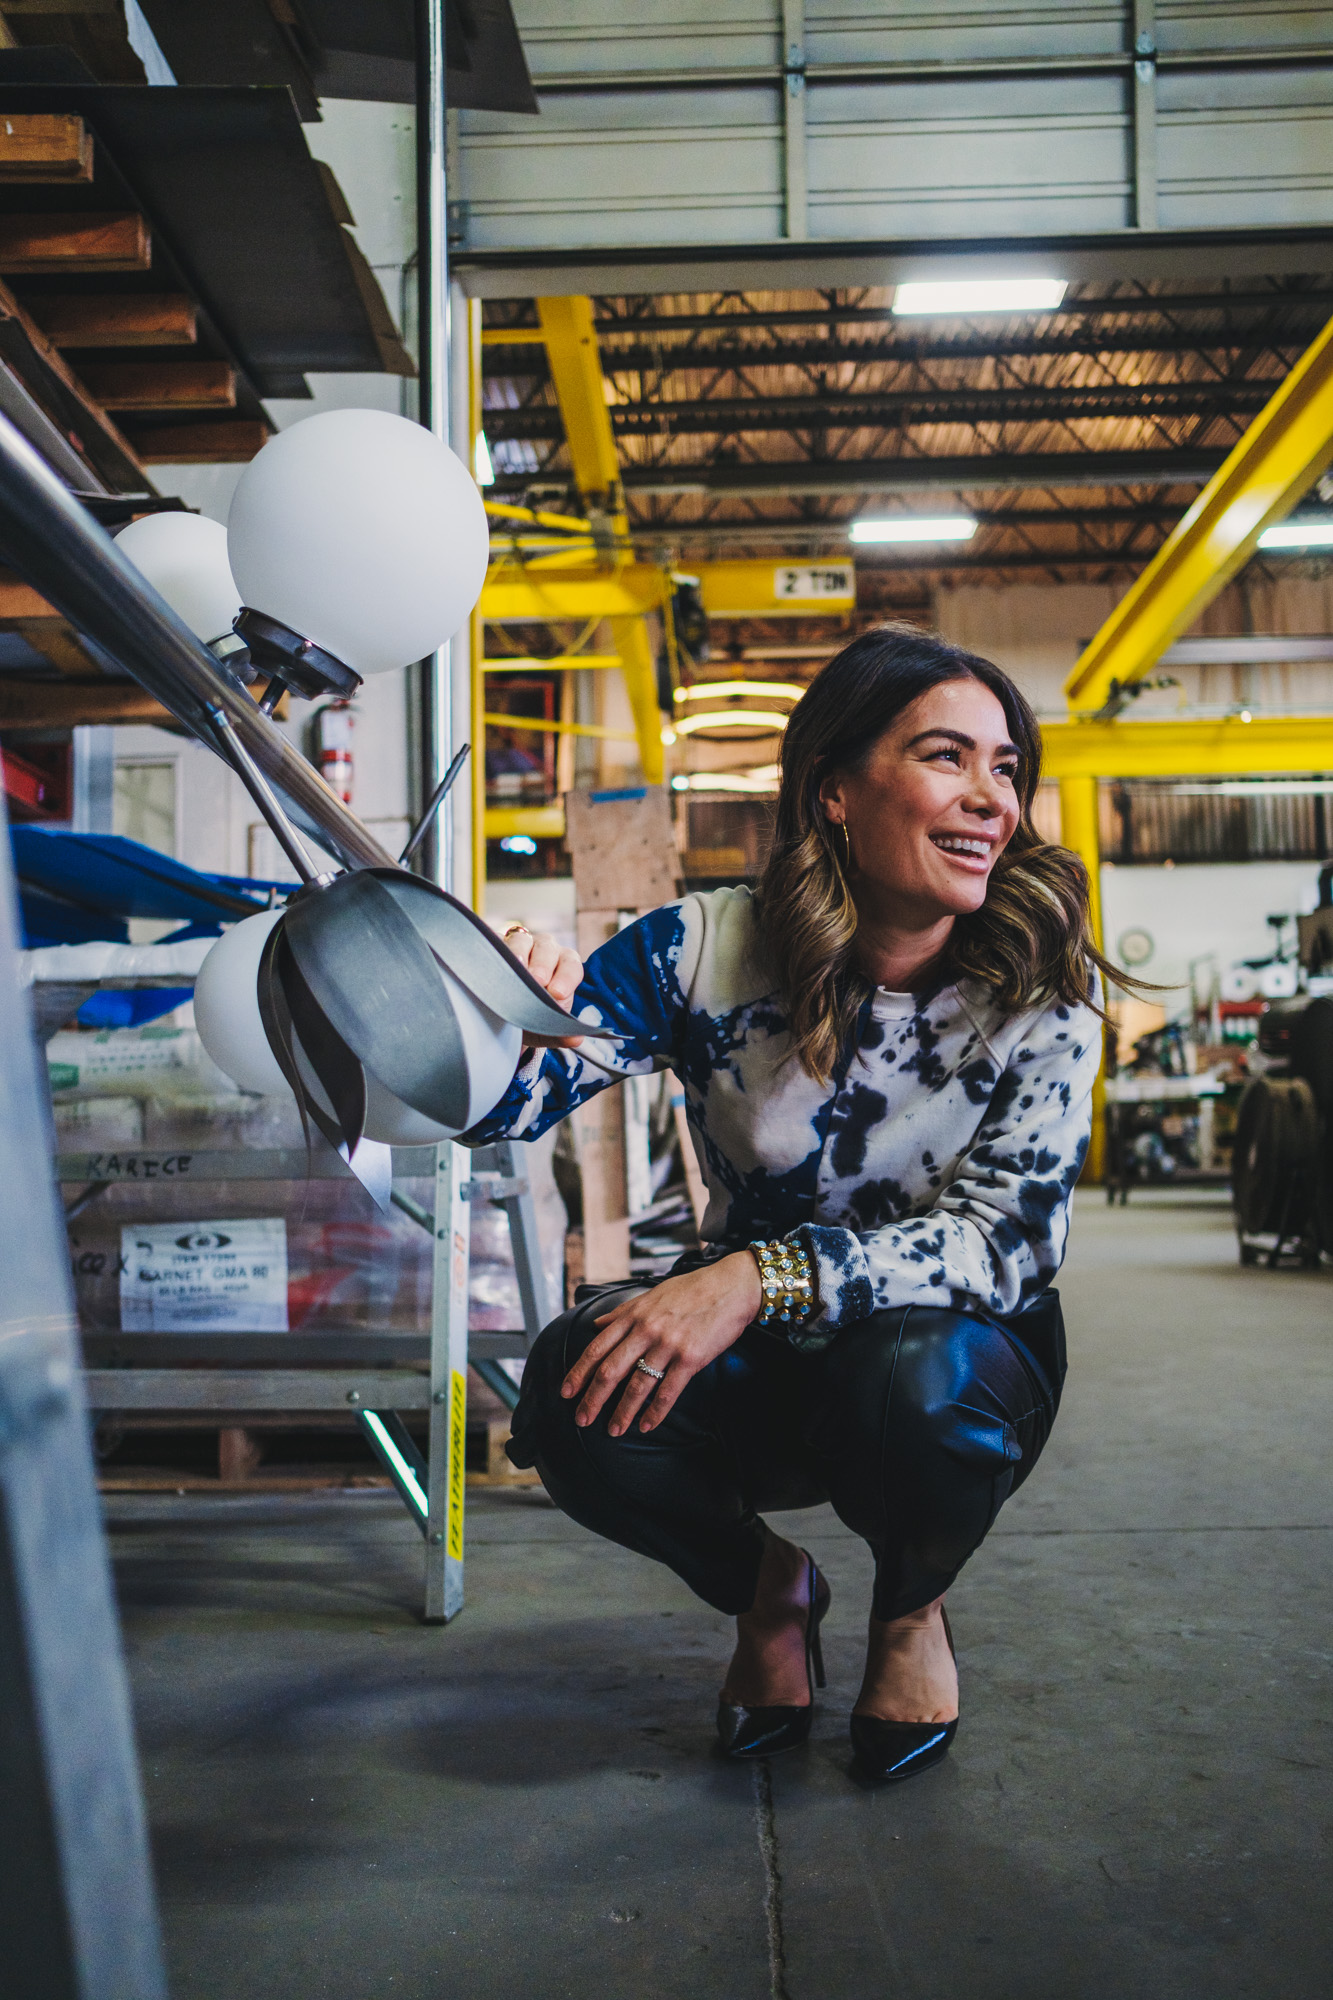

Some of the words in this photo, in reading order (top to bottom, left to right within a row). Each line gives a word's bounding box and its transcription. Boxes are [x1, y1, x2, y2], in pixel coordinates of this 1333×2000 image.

[785, 572, 797, 593] 2
[810, 571, 848, 592] TON
[213, 1266, 247, 1280] GMA
